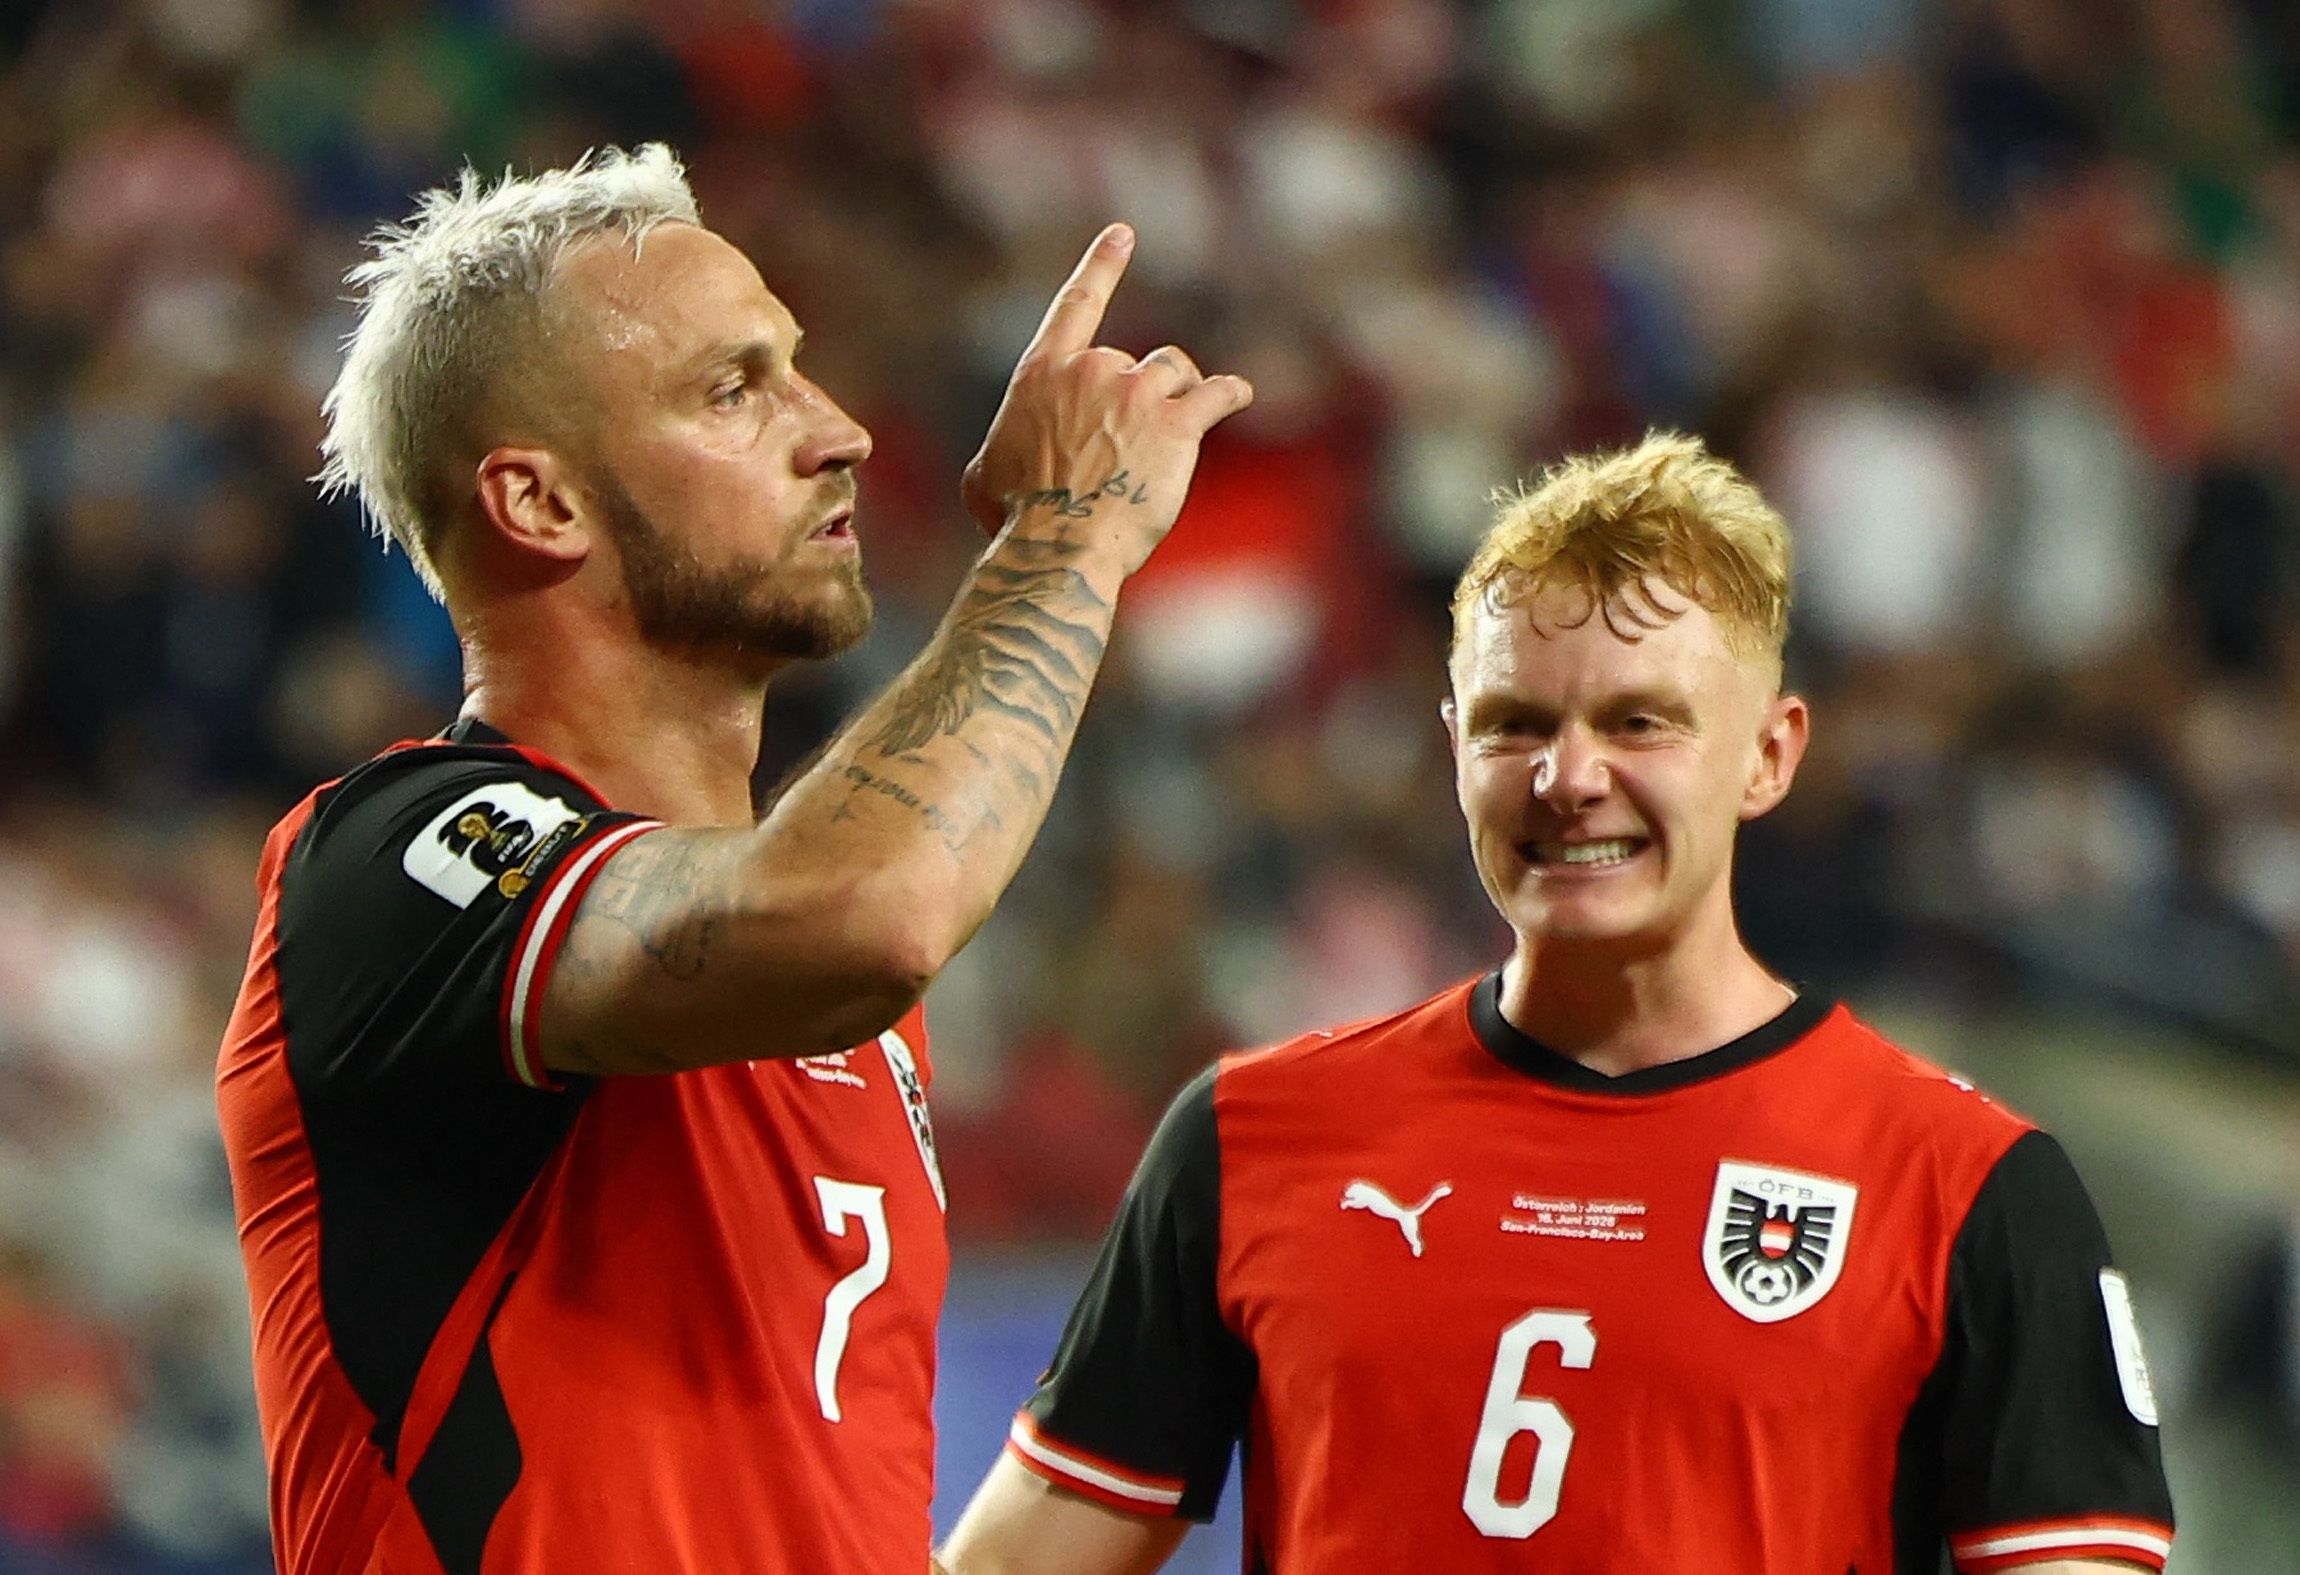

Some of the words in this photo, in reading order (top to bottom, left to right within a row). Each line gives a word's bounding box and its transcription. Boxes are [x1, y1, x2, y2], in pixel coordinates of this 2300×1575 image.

[1758, 1178, 1814, 1202] ÖFB
[1512, 1195, 1578, 1213] Österreich
[1585, 1202, 1646, 1215] Jordanien
[1500, 1220, 1645, 1241] San-Francisco-Bay-Area
[1556, 1214, 1583, 1226] Juni
[812, 1175, 892, 1424] 7
[1461, 1308, 1597, 1540] 6
